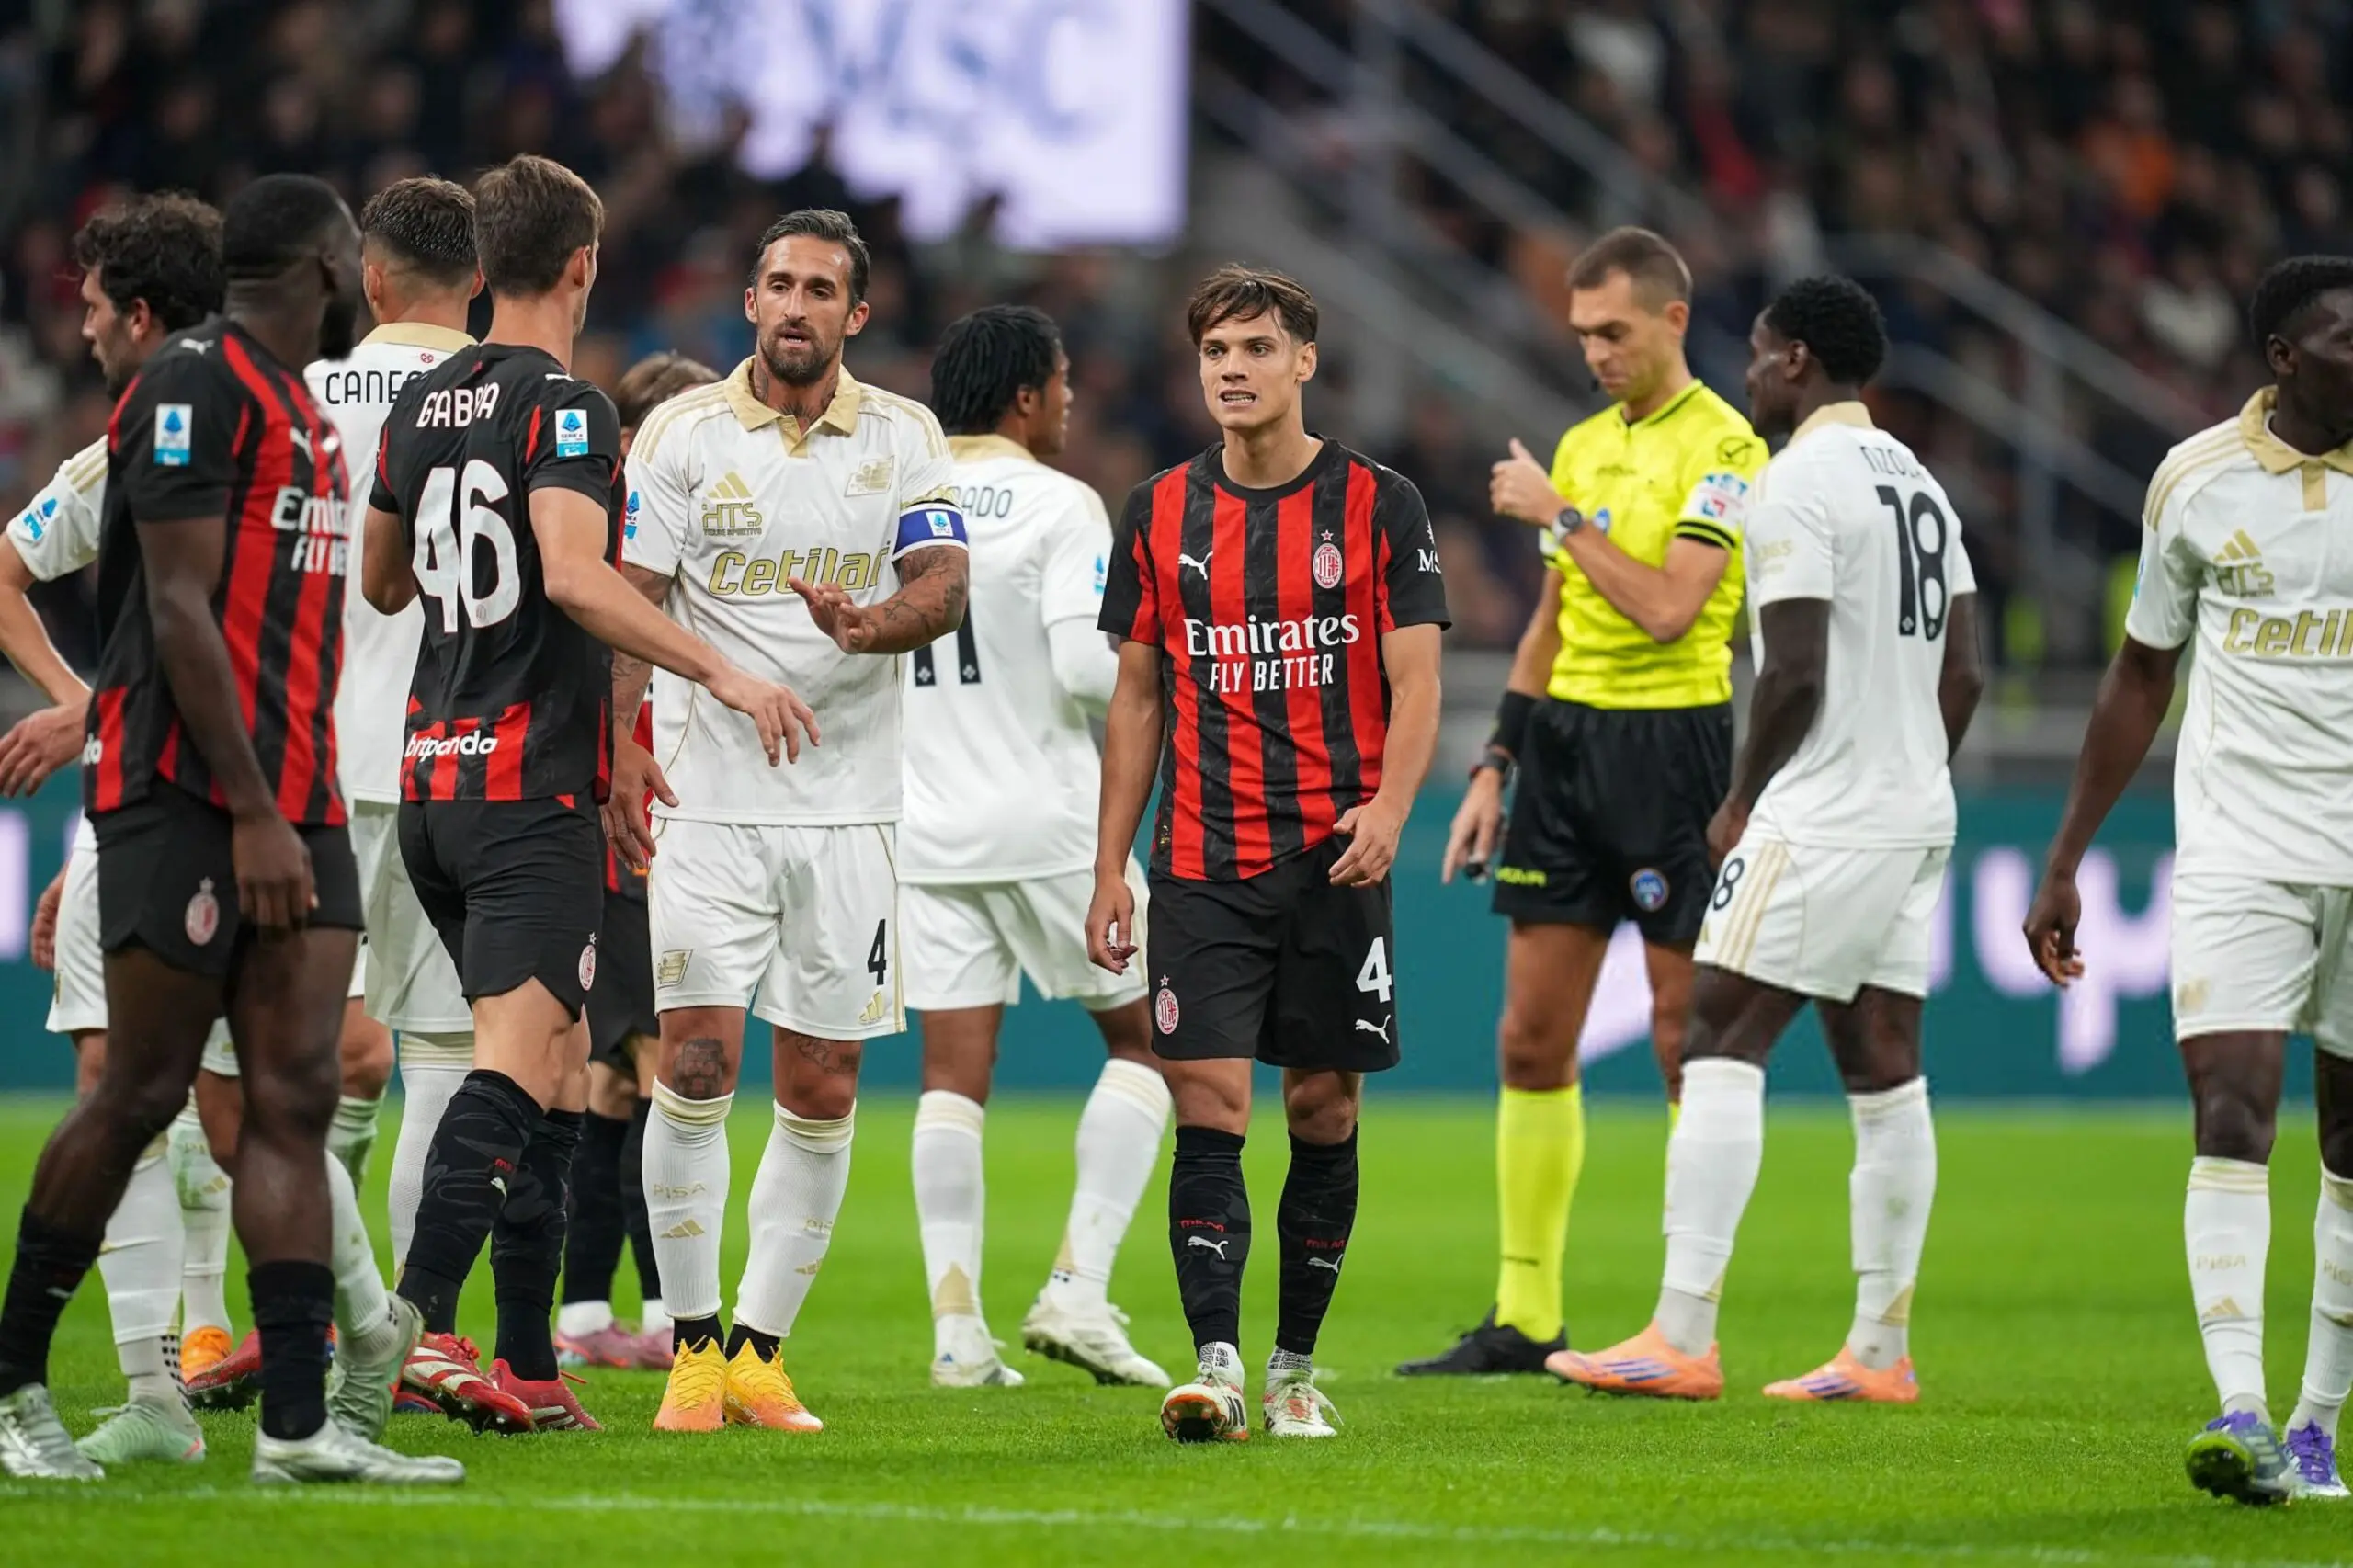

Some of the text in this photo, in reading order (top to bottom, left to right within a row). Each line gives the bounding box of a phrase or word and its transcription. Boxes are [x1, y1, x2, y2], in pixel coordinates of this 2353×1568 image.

[701, 502, 763, 528] HTS
[411, 459, 521, 634] 46
[709, 546, 890, 596] Cetilar
[1876, 484, 1947, 642] 18
[1183, 614, 1360, 656] Emirates
[1209, 653, 1334, 694] FLY BETTER
[867, 918, 887, 986] 4
[1356, 936, 1392, 1003] 4
